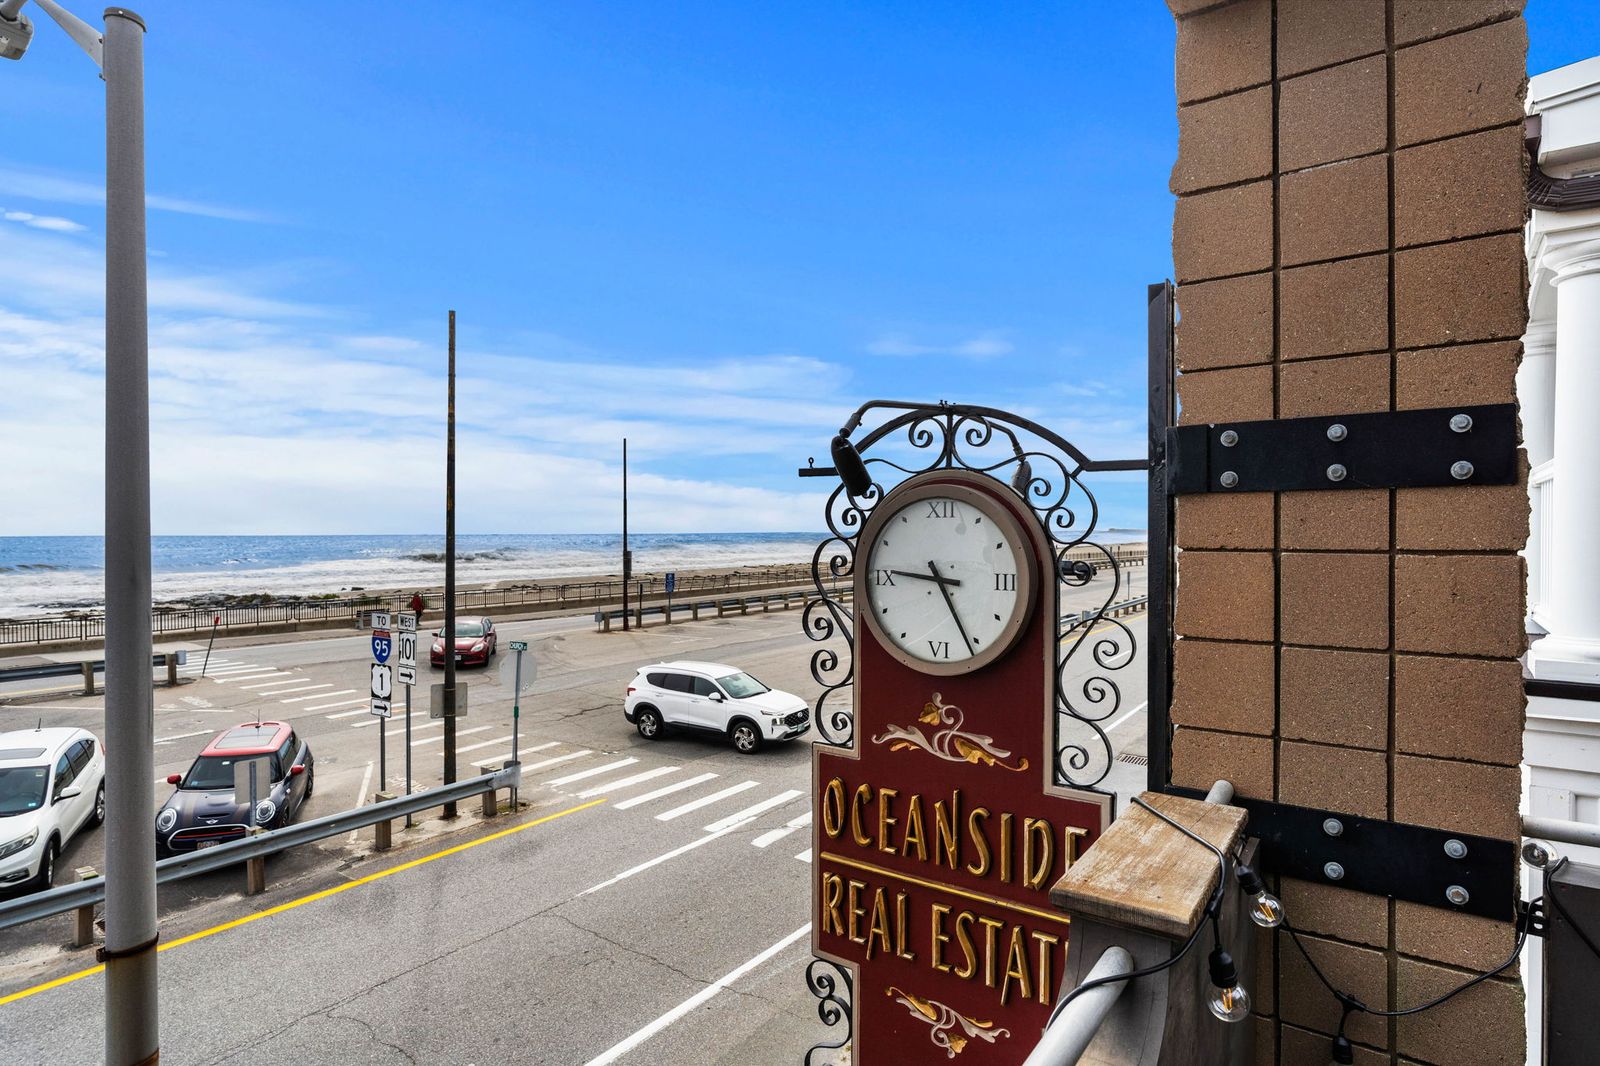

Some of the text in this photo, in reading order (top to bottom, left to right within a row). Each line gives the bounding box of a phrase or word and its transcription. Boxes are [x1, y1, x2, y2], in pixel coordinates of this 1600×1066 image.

[926, 501, 955, 519] XII
[875, 569, 1016, 592] IX III
[376, 615, 387, 626] TO
[399, 615, 415, 628] WEST
[374, 639, 389, 657] 95
[401, 638, 416, 661] 101
[927, 640, 951, 659] VI
[379, 673, 384, 691] 1
[822, 871, 1070, 1007] REAL ESTAT
